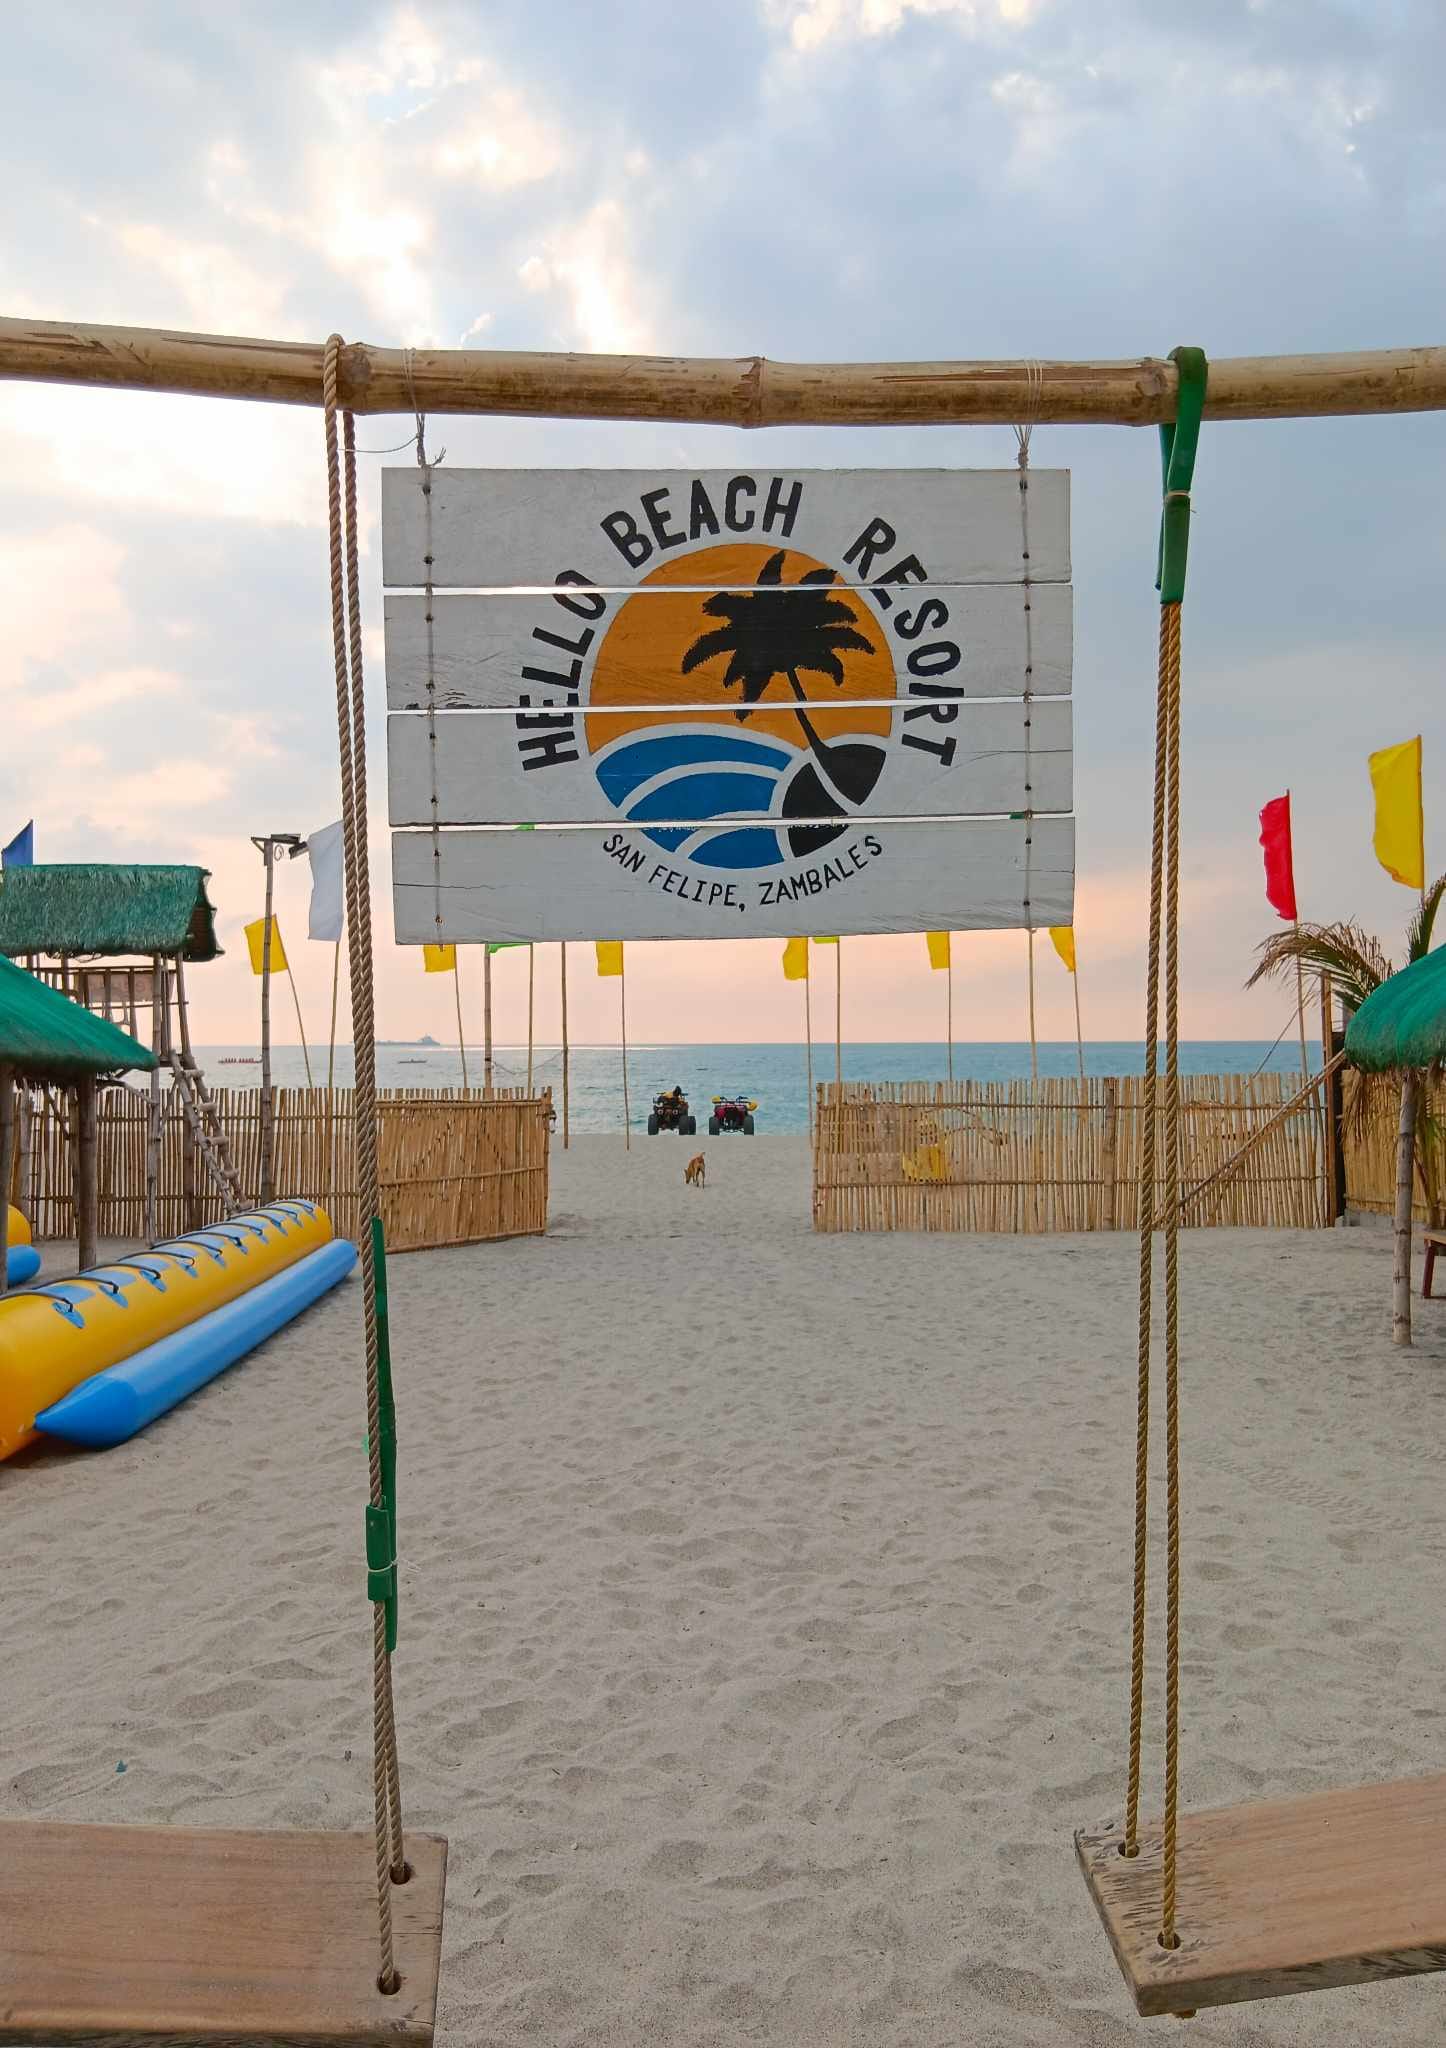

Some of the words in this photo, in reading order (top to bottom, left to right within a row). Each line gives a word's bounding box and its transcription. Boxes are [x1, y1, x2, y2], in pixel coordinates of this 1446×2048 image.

[516, 569, 607, 771] HELLO
[601, 475, 804, 568] BEACH
[843, 517, 965, 767] RESORT
[602, 834, 647, 873] SAN
[648, 864, 745, 912] FELIPE,
[758, 835, 883, 905] ZAMBALES
